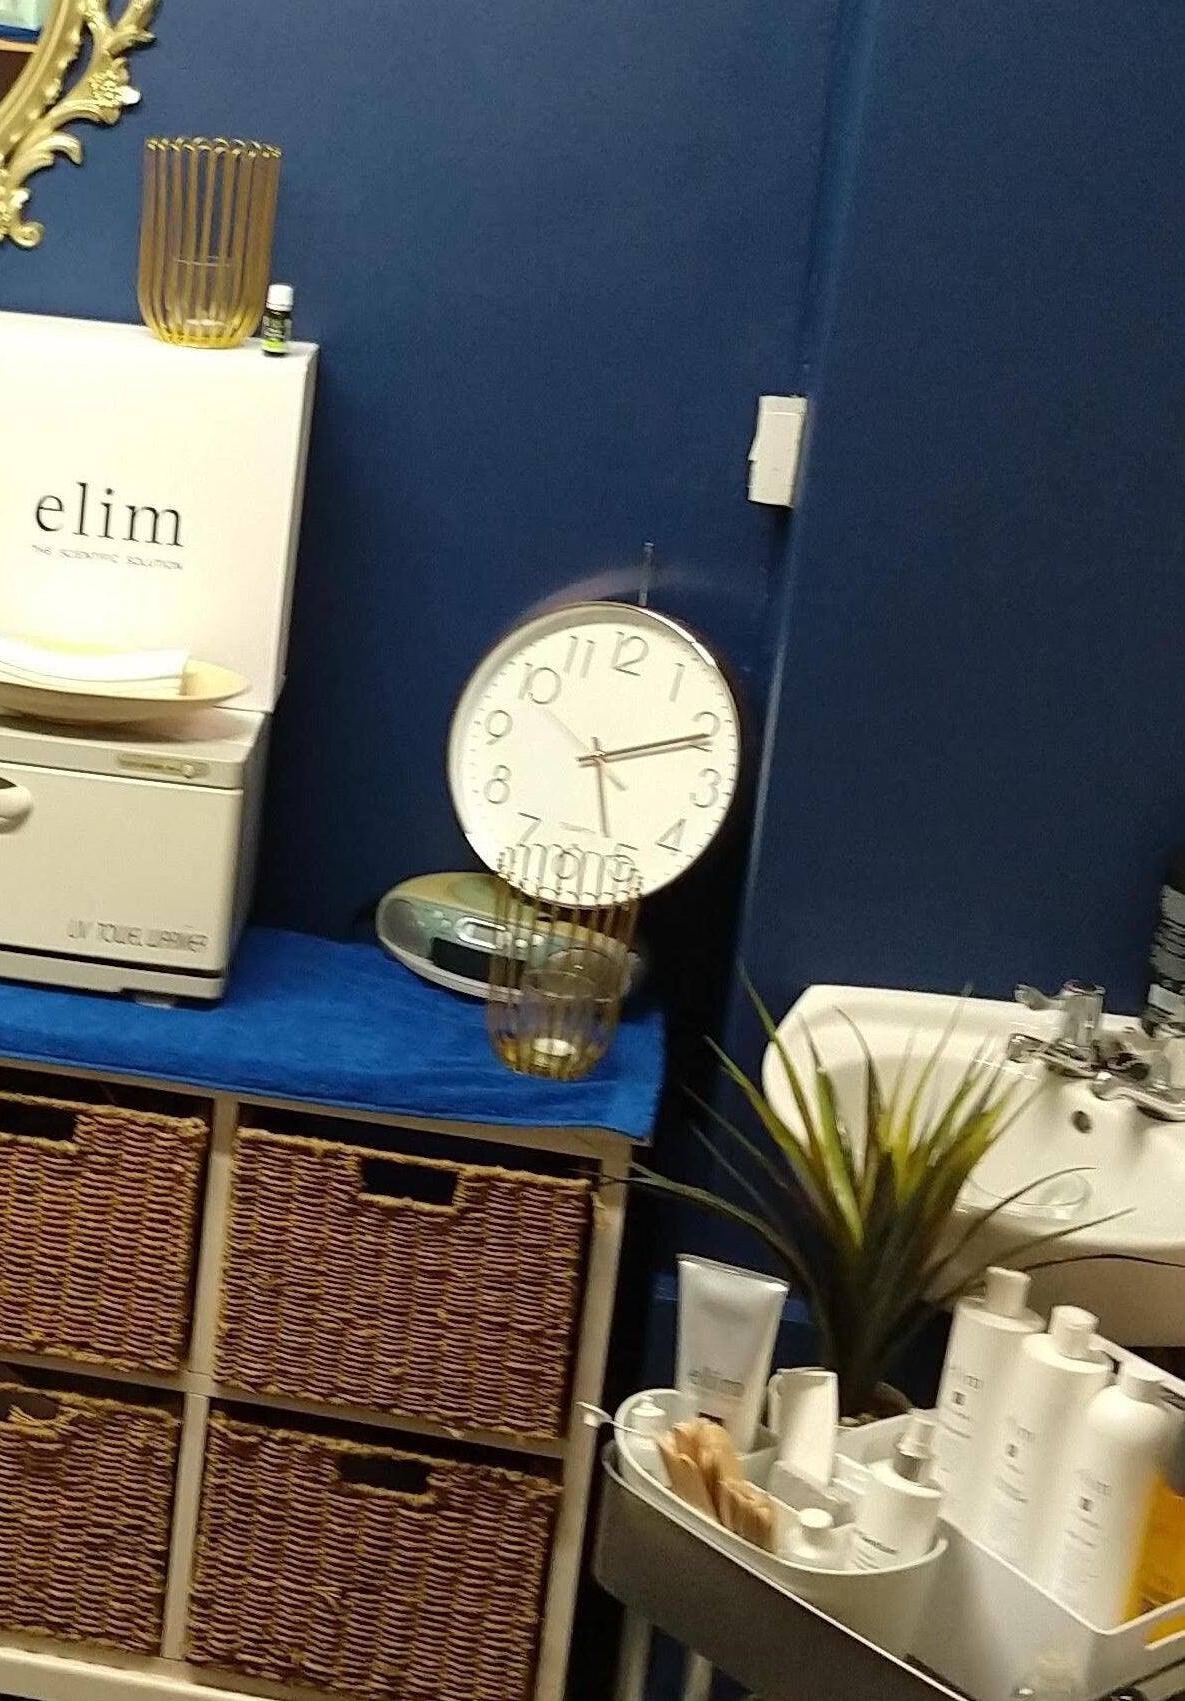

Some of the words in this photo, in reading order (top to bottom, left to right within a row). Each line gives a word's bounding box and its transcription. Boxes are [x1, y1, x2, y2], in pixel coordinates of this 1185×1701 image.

[34, 480, 184, 548] elim
[563, 634, 596, 679] 11
[610, 631, 650, 677] 12
[517, 662, 563, 705] 10
[668, 661, 686, 703] 1
[483, 709, 514, 745] 9
[690, 711, 721, 753] 2
[483, 764, 513, 805] 8
[689, 768, 723, 809] 3
[517, 811, 543, 846] 7
[654, 818, 688, 853] 4
